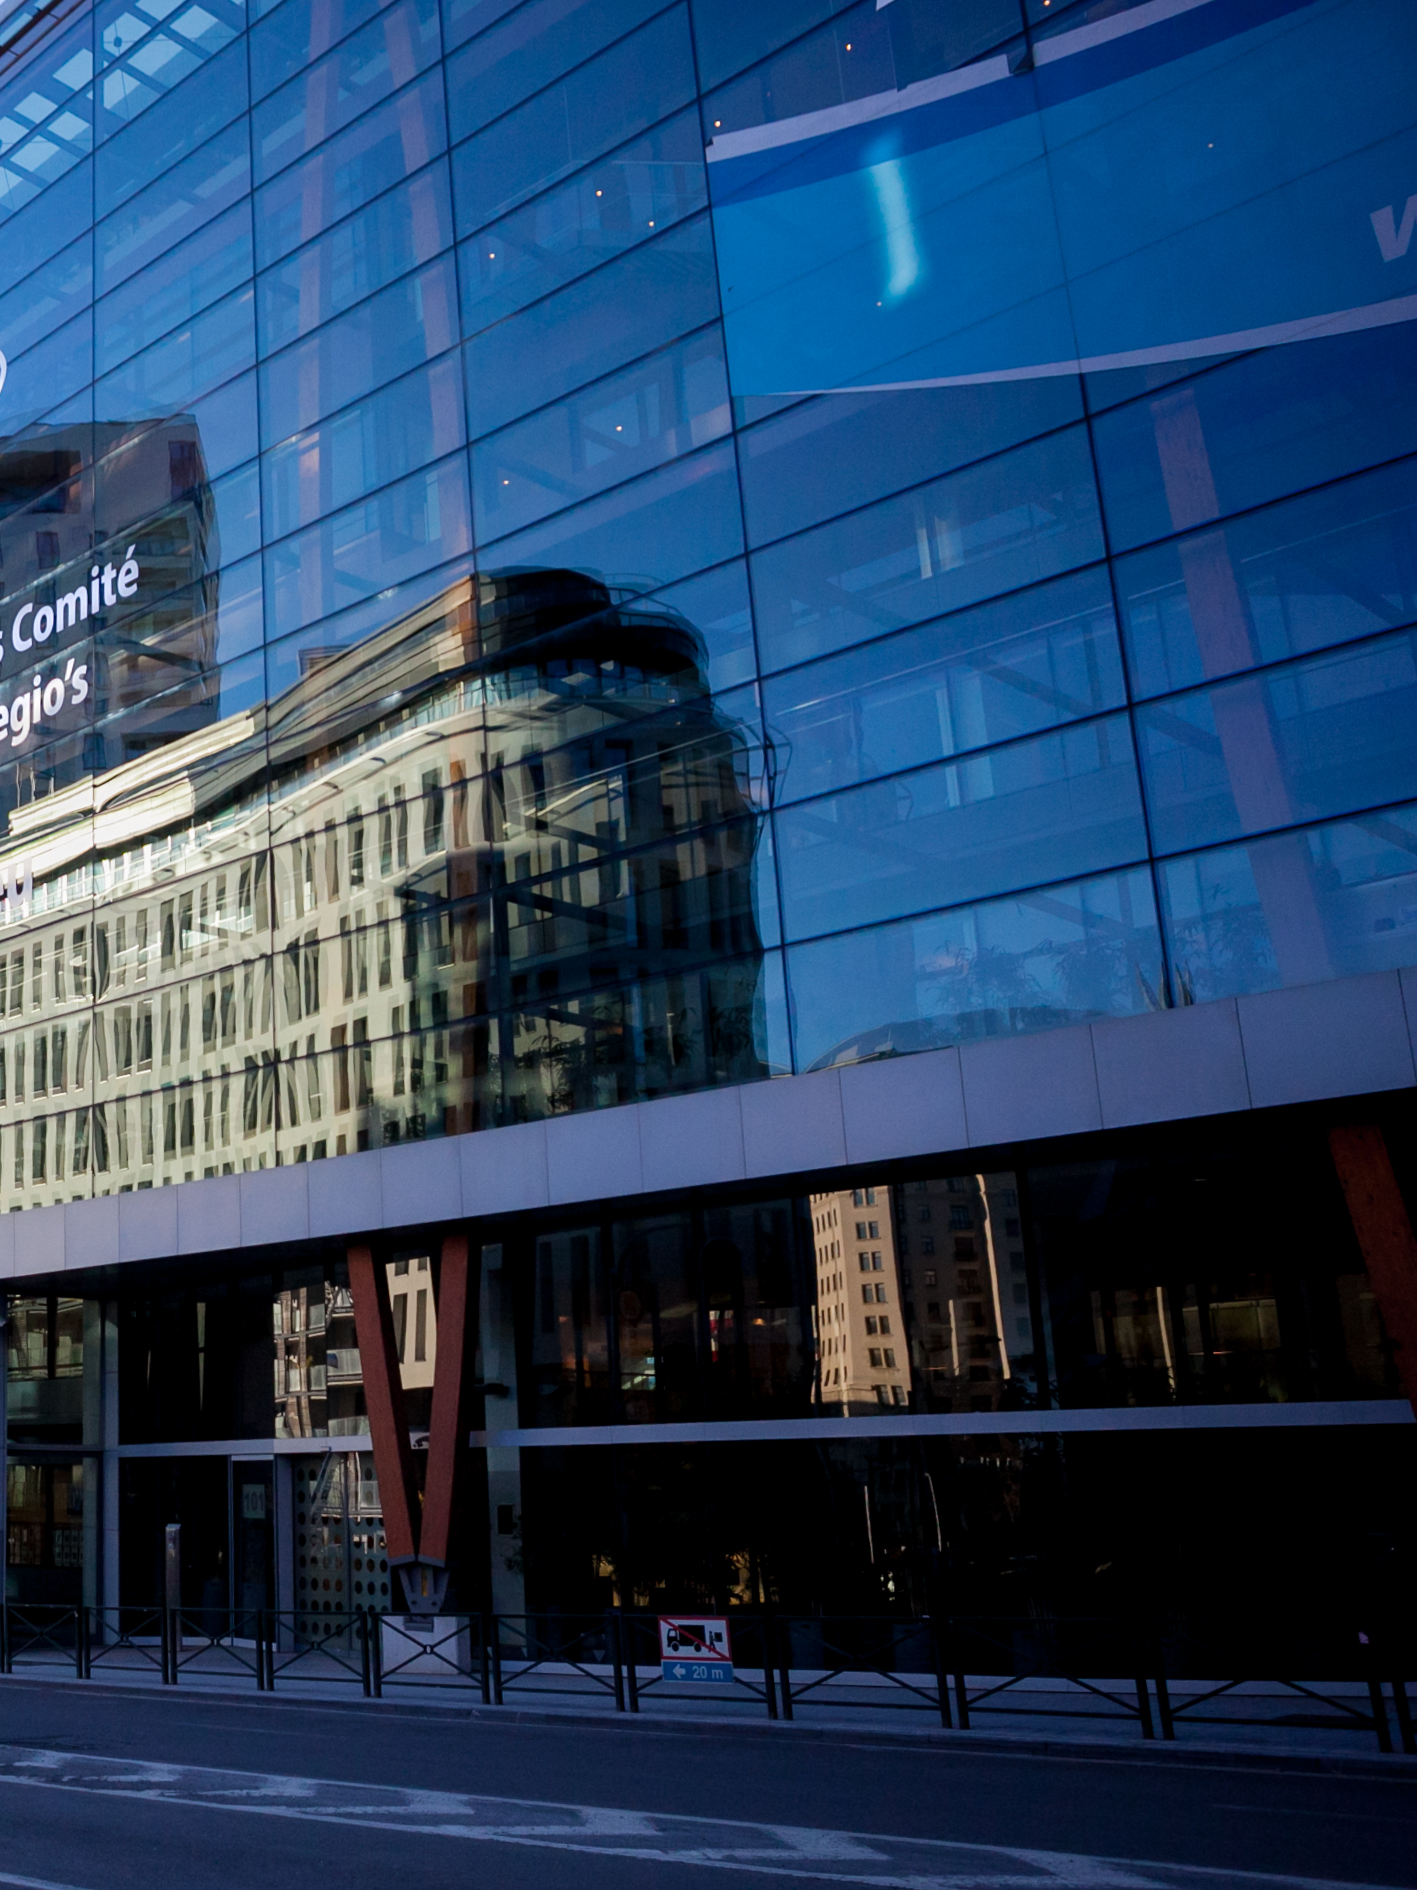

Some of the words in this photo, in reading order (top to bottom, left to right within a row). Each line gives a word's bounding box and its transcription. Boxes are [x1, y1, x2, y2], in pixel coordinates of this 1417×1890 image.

[12, 544, 139, 652] Comité
[244, 1491, 264, 1511] 101
[692, 1666, 708, 1679] 20
[712, 1669, 724, 1680] m
